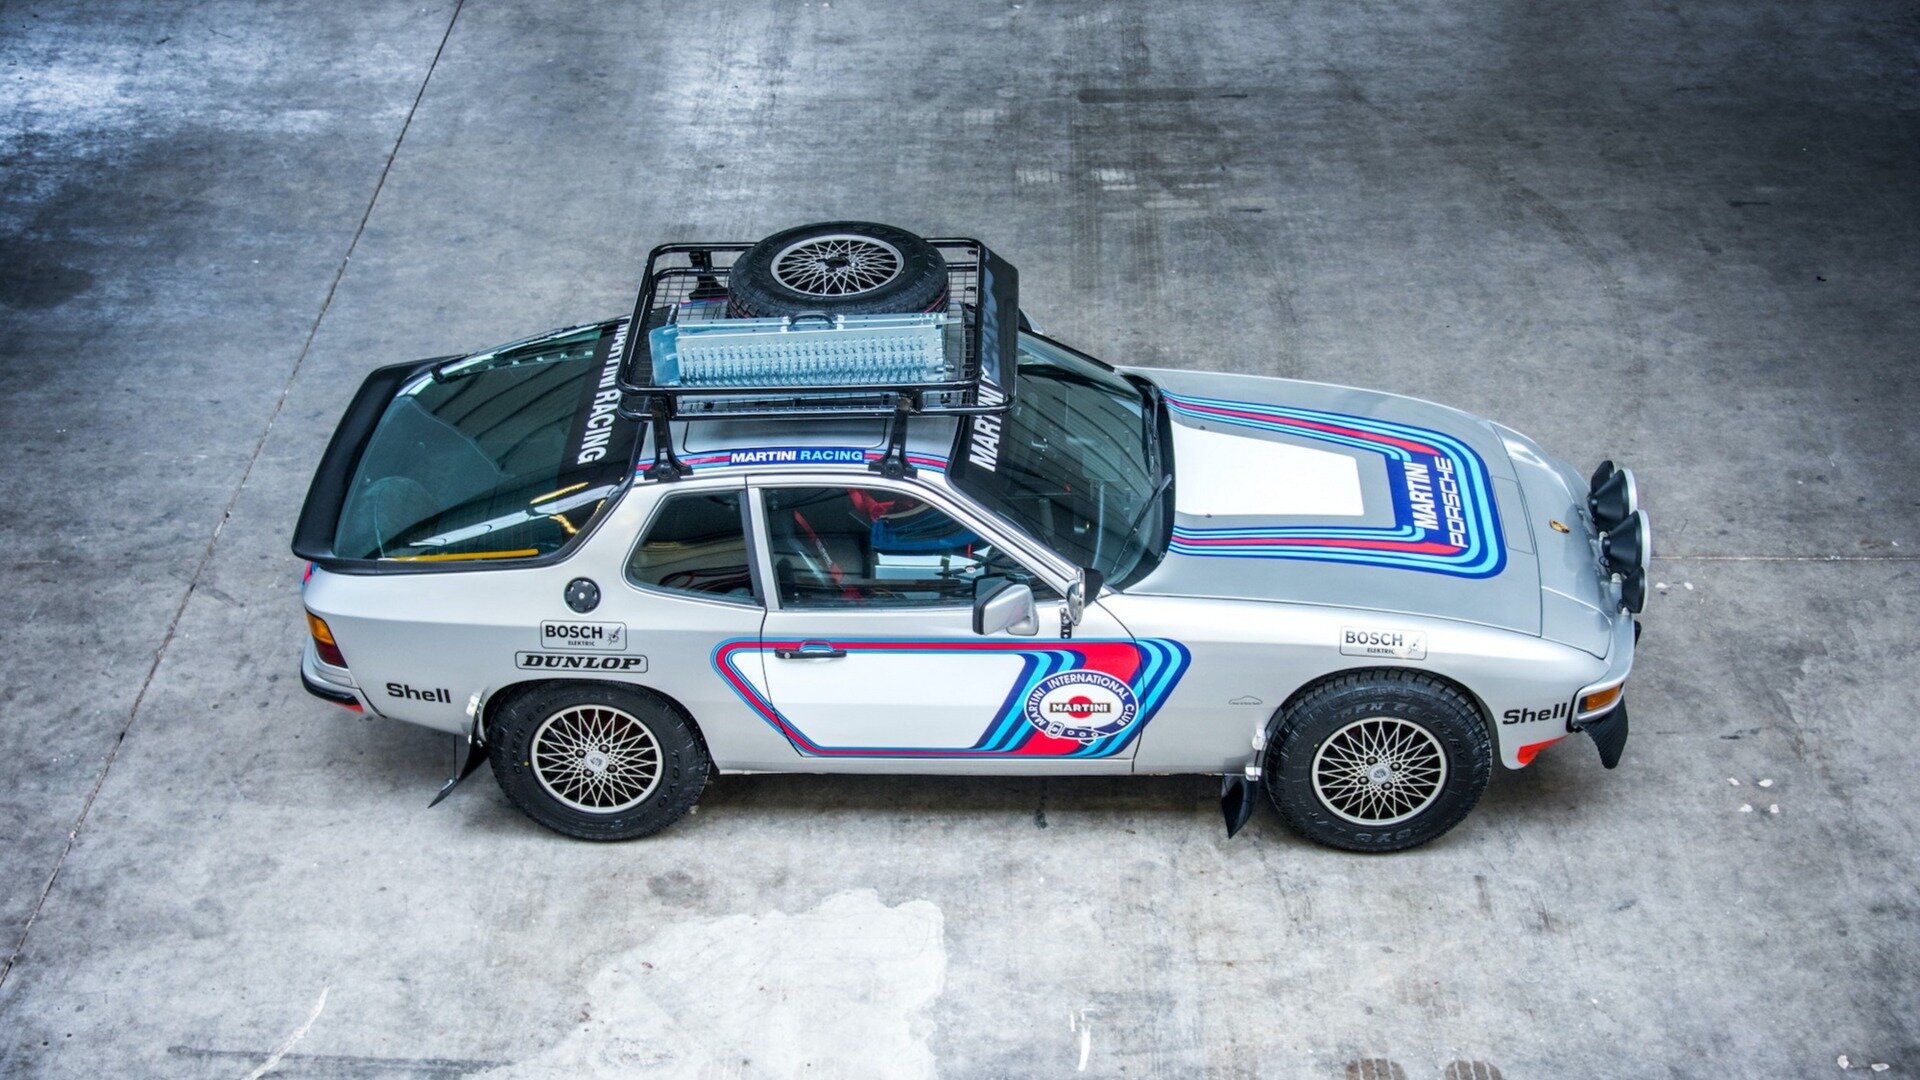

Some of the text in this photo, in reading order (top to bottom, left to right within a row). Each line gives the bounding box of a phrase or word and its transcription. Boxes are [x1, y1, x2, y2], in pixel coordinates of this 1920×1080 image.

[577, 388, 621, 465] RACING
[730, 449, 864, 464] MARTINI RACING
[1403, 461, 1440, 531] MARTINI
[1435, 456, 1469, 548] PORSCHE
[545, 624, 603, 640] BOSCH
[1345, 631, 1404, 647] BOSCH
[1366, 647, 1396, 655] ELEKTRIC
[522, 655, 642, 670] DUNLOP
[386, 682, 452, 704] Shell
[1028, 673, 1134, 727] MARTINI INTERNATIONAL CLUB
[1053, 703, 1109, 713] MARTINI
[1503, 702, 1568, 725] Shell
